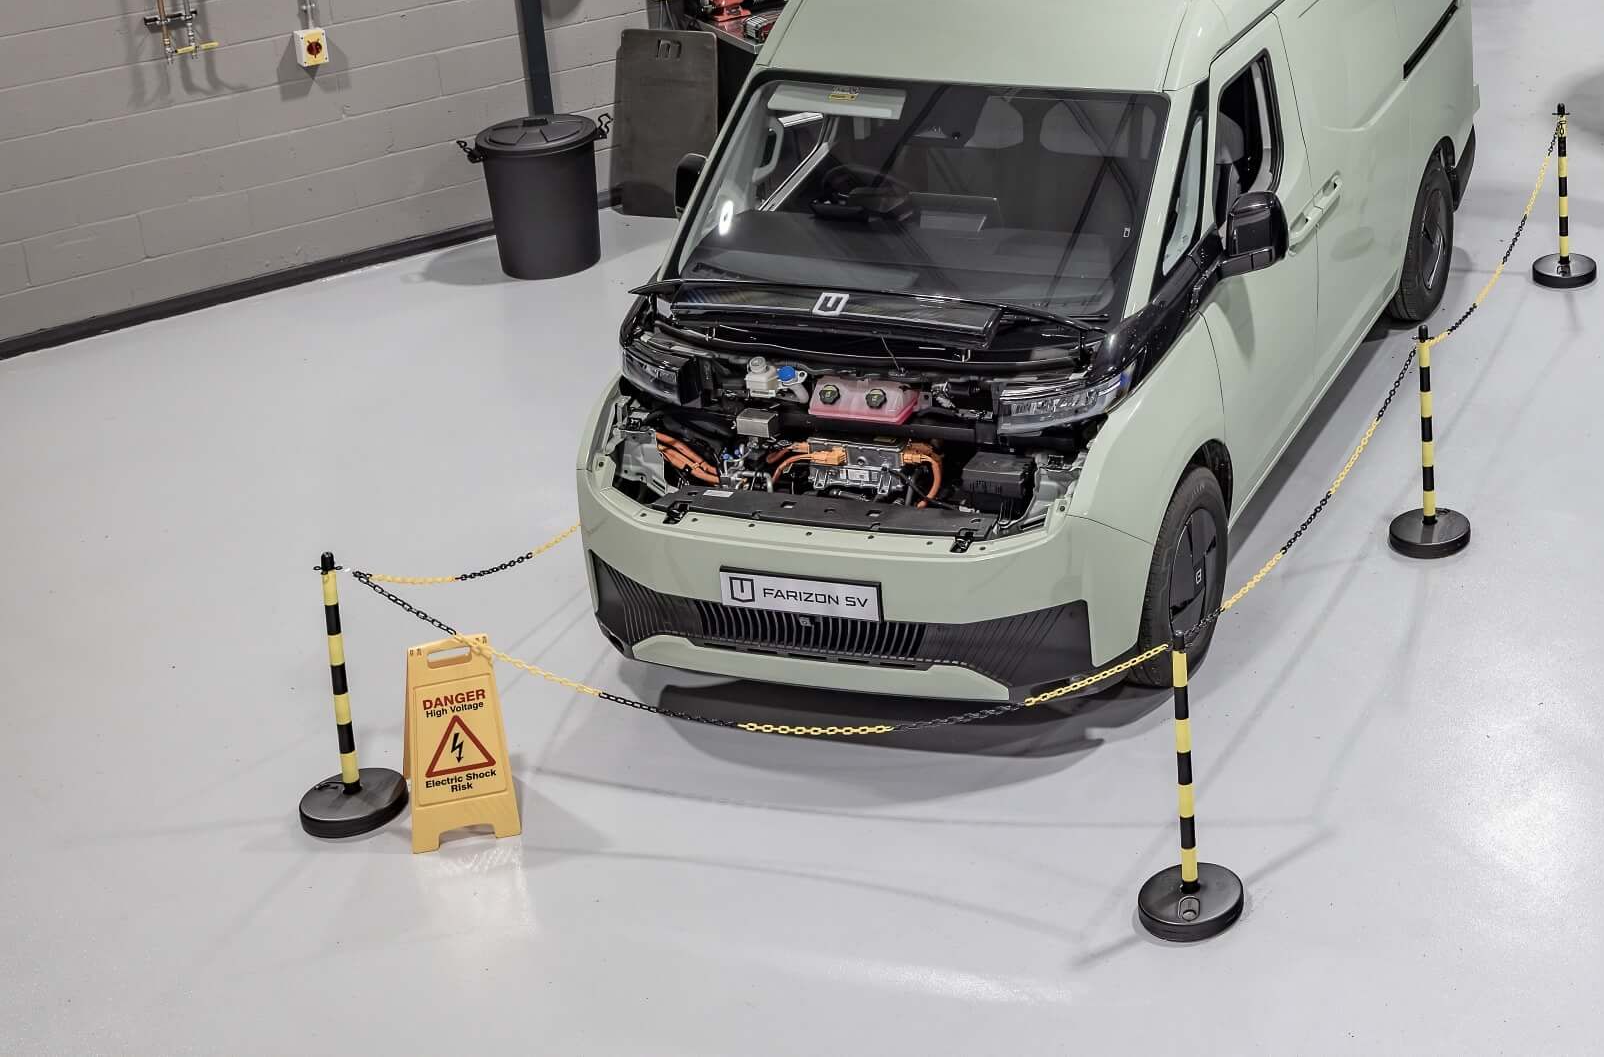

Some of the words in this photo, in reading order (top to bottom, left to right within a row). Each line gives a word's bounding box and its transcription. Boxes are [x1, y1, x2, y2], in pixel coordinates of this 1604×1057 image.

[763, 588, 840, 605] FARIZON
[845, 596, 869, 608] SV
[422, 689, 486, 711] DANGER
[426, 707, 448, 718] High
[450, 701, 484, 713] Voltage
[425, 775, 463, 788] Electric
[466, 769, 497, 781] Shock
[451, 782, 473, 793] Risk
